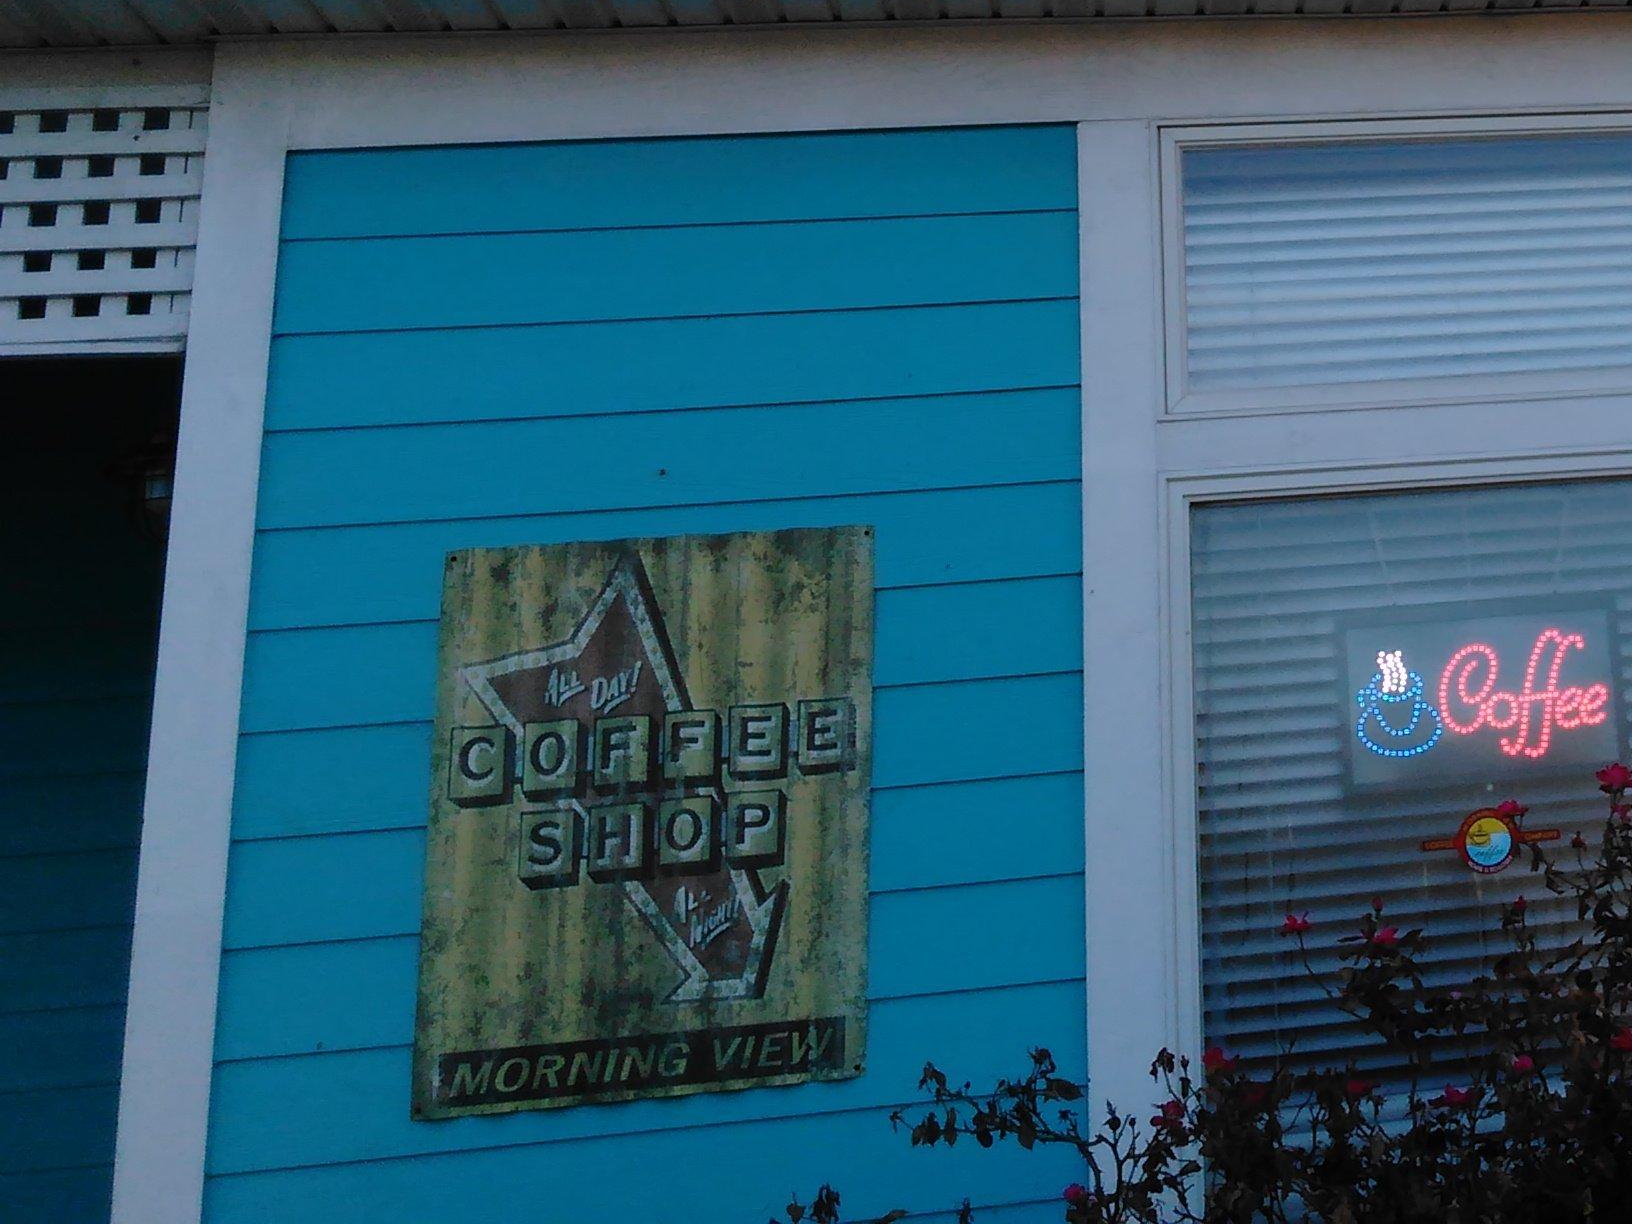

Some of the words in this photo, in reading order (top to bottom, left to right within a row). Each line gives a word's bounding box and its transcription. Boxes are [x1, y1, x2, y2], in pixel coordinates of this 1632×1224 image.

[544, 666, 586, 709] ALL
[590, 660, 642, 715] DAY!
[1438, 628, 1609, 758] Coffee
[455, 701, 843, 782] COFFEE
[526, 801, 773, 869] SHOP
[449, 1038, 691, 1099] MORNING
[711, 1025, 837, 1073] VIEW
